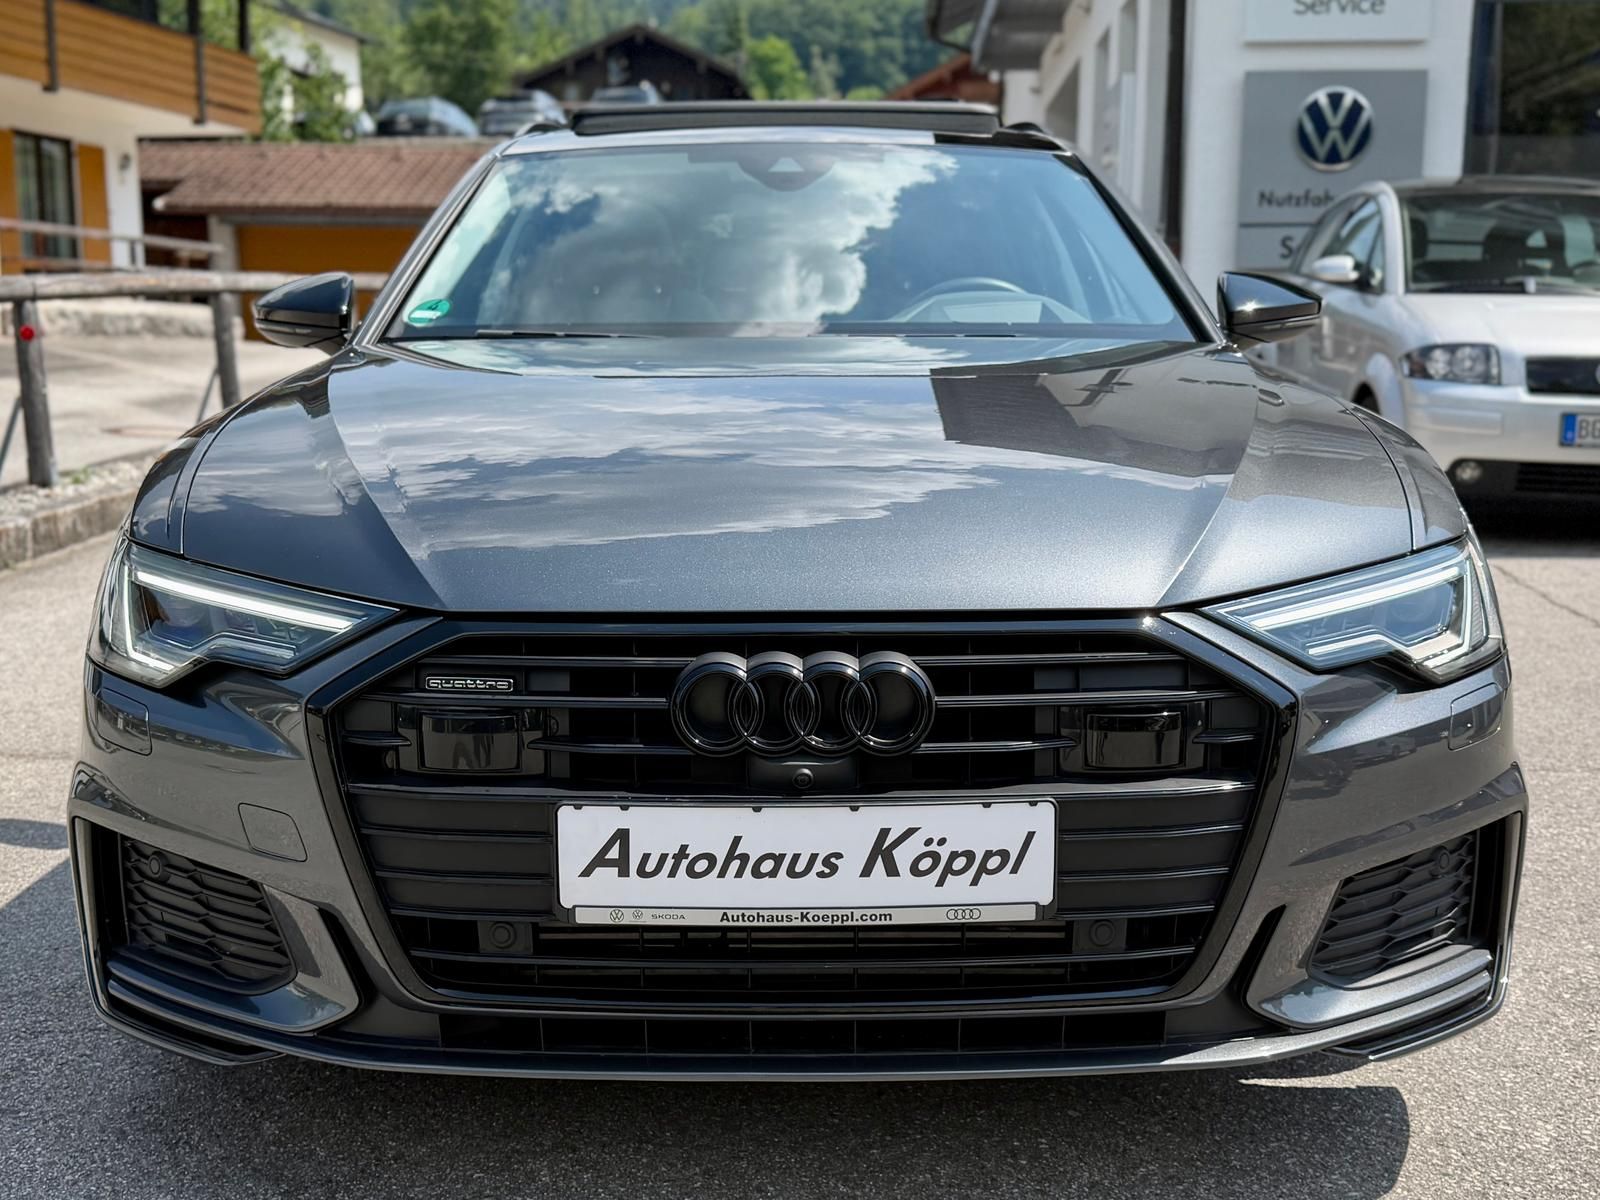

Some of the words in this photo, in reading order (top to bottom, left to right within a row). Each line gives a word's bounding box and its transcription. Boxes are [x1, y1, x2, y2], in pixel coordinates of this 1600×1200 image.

[1294, 0, 1385, 15] Service
[429, 679, 509, 689] quattro
[578, 827, 844, 880] Autohaus
[859, 826, 1037, 888] Köppl
[719, 911, 893, 925] Autohaus-Koeppl.com
